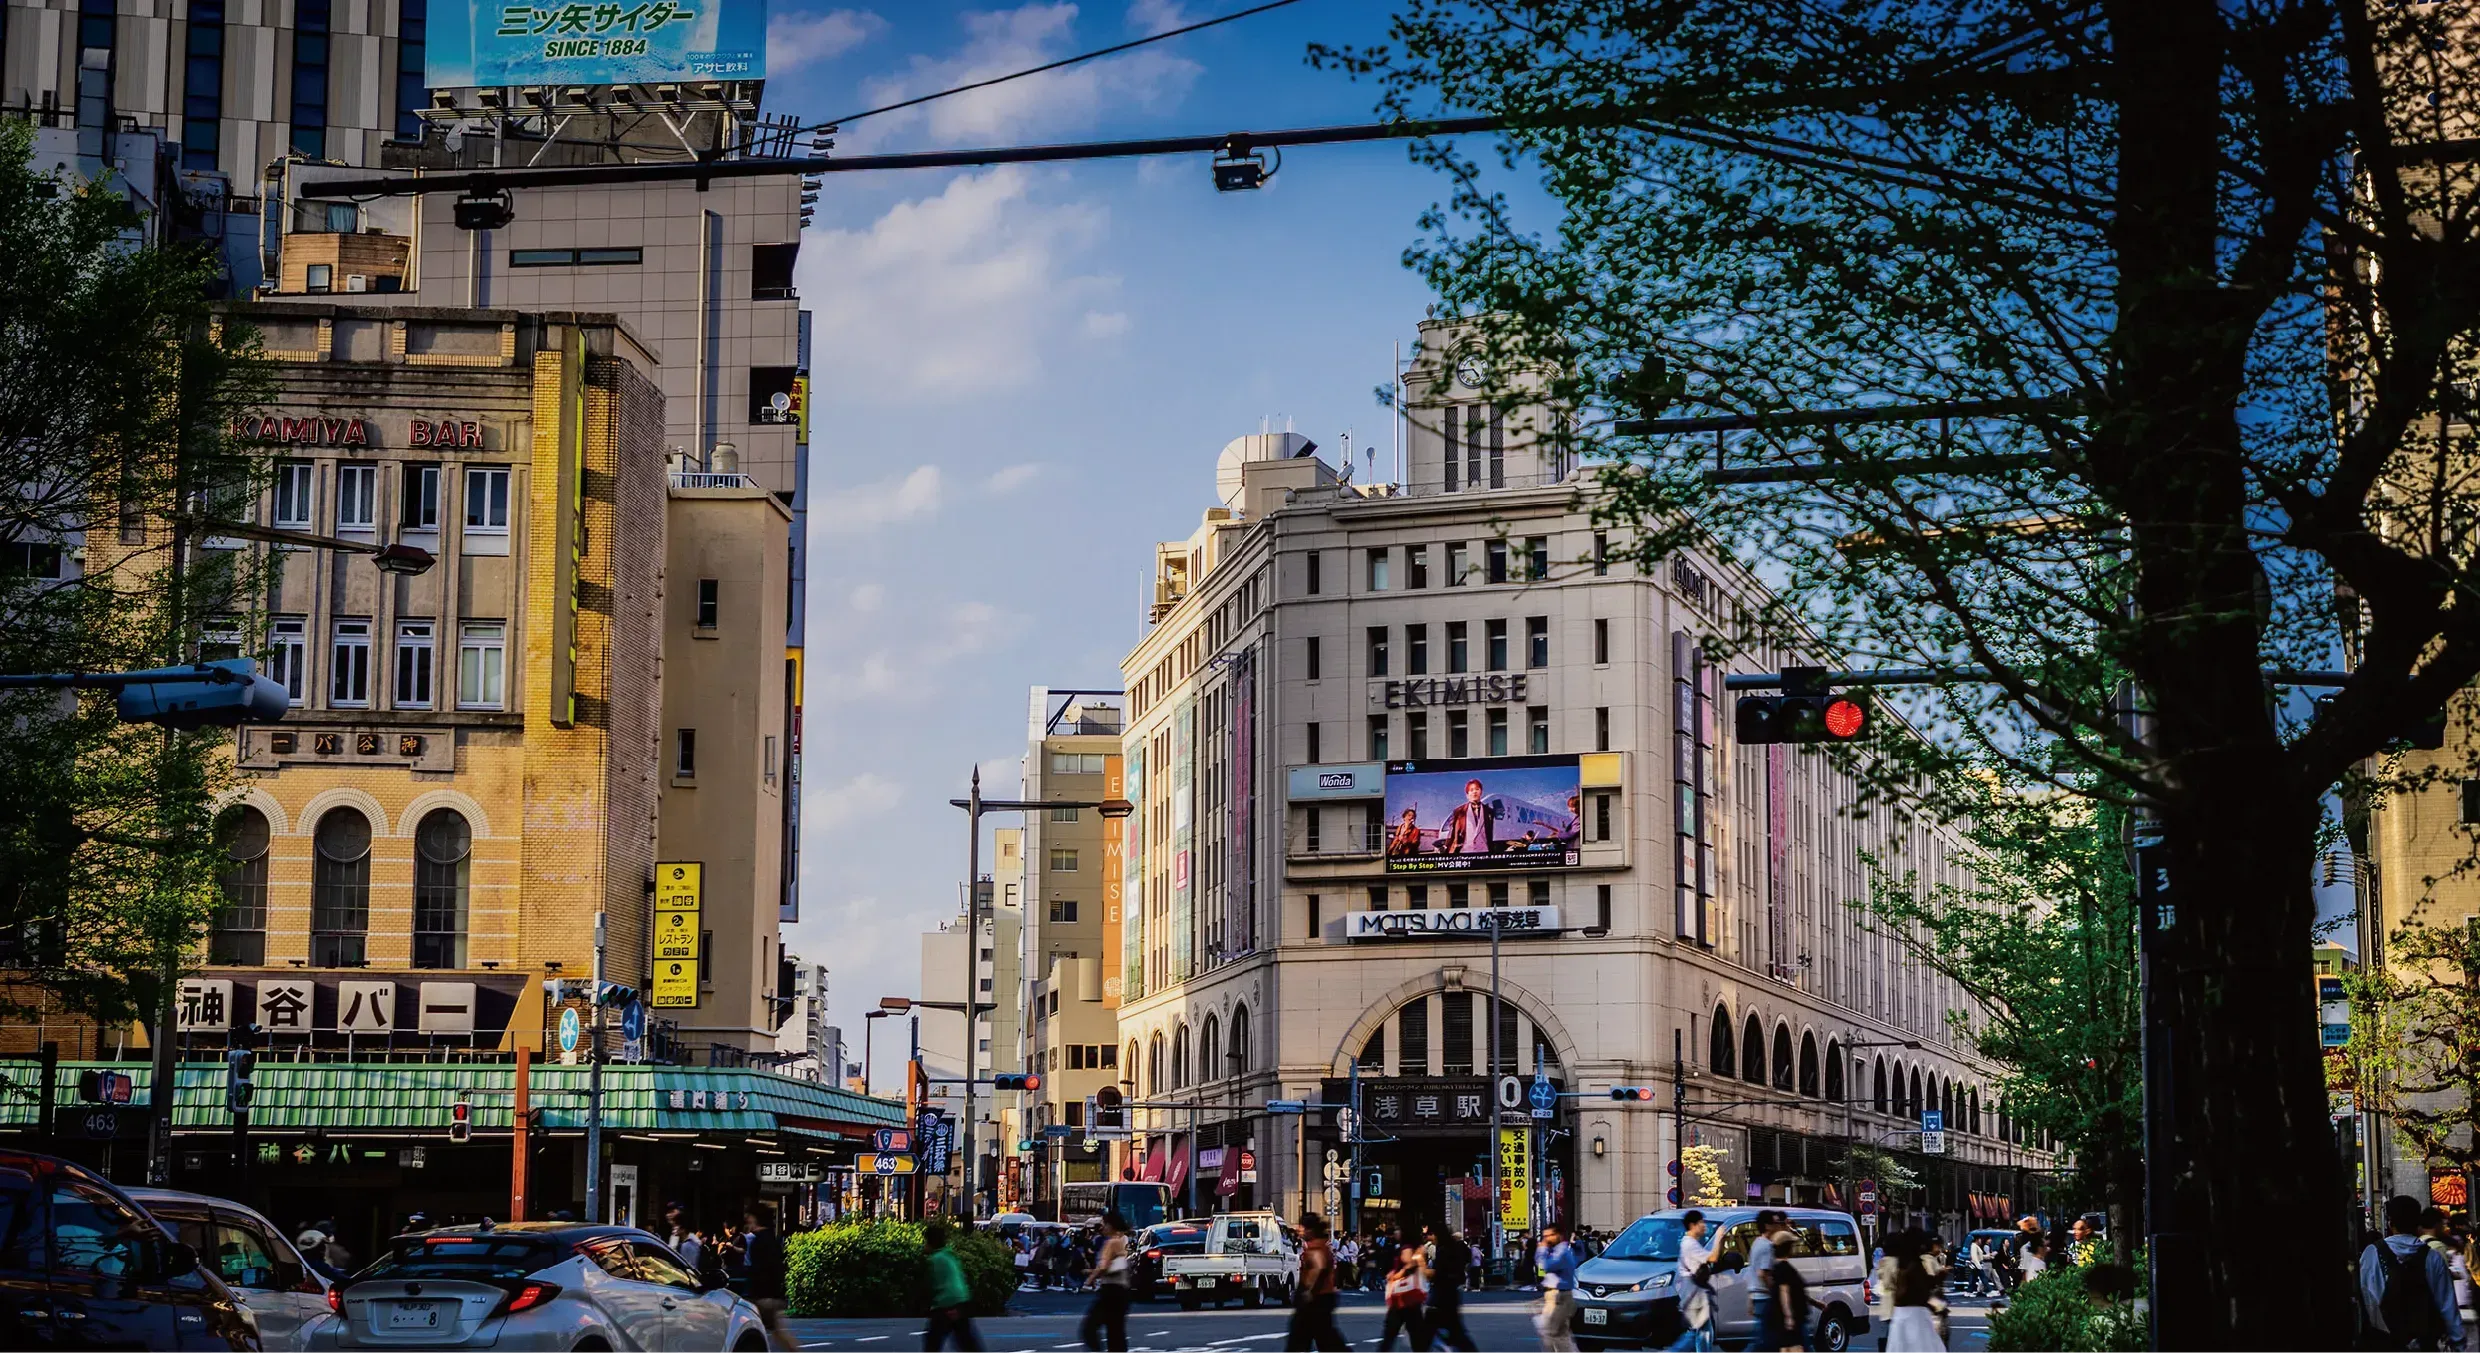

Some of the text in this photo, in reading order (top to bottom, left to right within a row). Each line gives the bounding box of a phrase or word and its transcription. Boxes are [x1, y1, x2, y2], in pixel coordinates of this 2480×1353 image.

[497, 1, 695, 36] 三ツ矢サイダー
[545, 38, 647, 58] SINCE 1884
[692, 61, 749, 74] アサヒ飲料
[231, 416, 485, 448] KAMIYA BAR
[1384, 673, 1528, 710] EKIMISE
[1320, 775, 1351, 787] Wonda
[1107, 776, 1124, 922] EIMISE
[659, 934, 695, 945] レストラン
[663, 947, 689, 956] カミヤ
[178, 986, 468, 1028] 神谷バー
[1374, 1095, 1481, 1119] 浅草駅
[86, 1114, 116, 1131] 463
[883, 1133, 891, 1146] 6
[256, 1142, 387, 1165] 神谷バー
[875, 1157, 896, 1170] 463
[1512, 1130, 1525, 1189] 交通事故の
[1501, 1142, 1512, 1214] ない街浅草を
